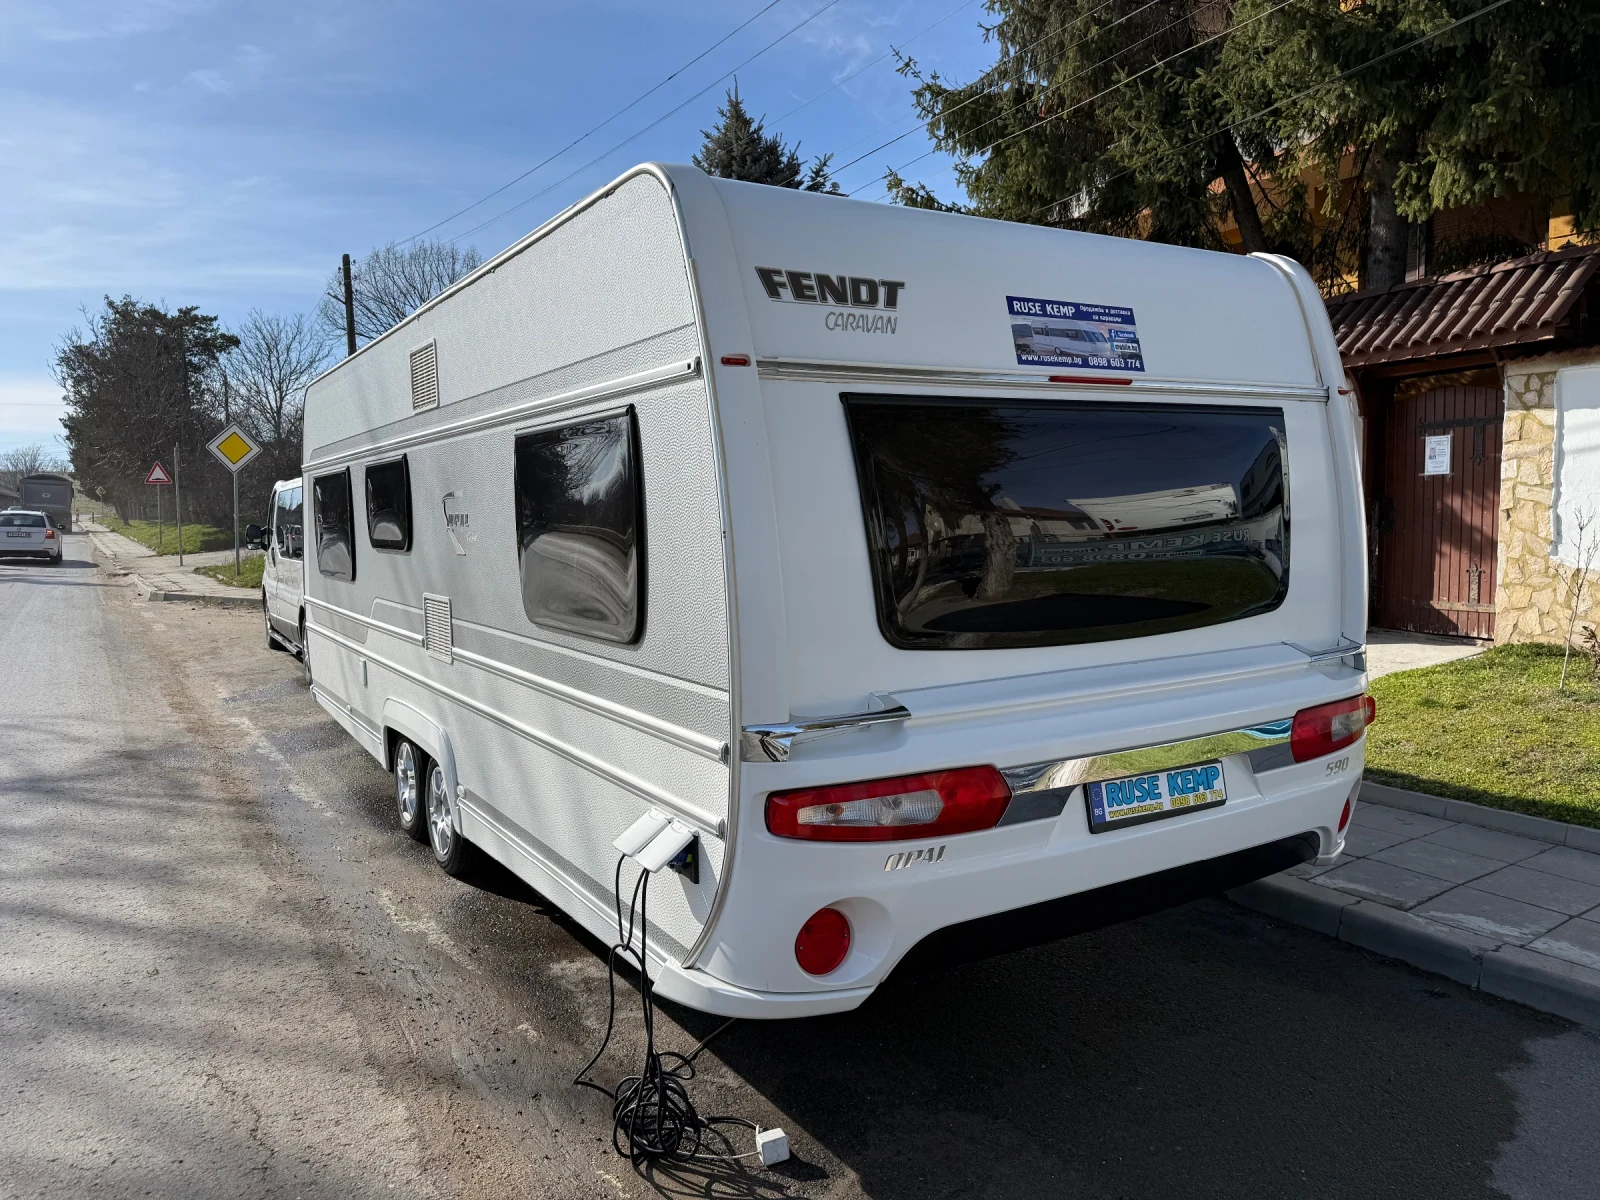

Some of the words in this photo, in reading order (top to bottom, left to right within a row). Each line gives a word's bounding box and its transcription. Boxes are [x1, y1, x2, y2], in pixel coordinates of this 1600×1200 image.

[754, 266, 905, 309] FENDT
[1013, 300, 1042, 314] RUSE
[1045, 303, 1075, 317] KEMP
[824, 311, 897, 335] CARAVAN
[1021, 354, 1082, 365] www.rusekemp.bg
[1088, 356, 1108, 367] 0898
[1110, 357, 1125, 367] 603
[1127, 359, 1141, 368] 774
[1325, 757, 1350, 778] 590
[1105, 775, 1162, 808] RUSE
[1167, 765, 1220, 797] KEMP
[1094, 807, 1103, 816] BG
[1108, 801, 1164, 818] www.rusekemp.bg
[1170, 794, 1190, 808] 0898
[1192, 791, 1208, 804] 603
[1210, 788, 1224, 800] 774
